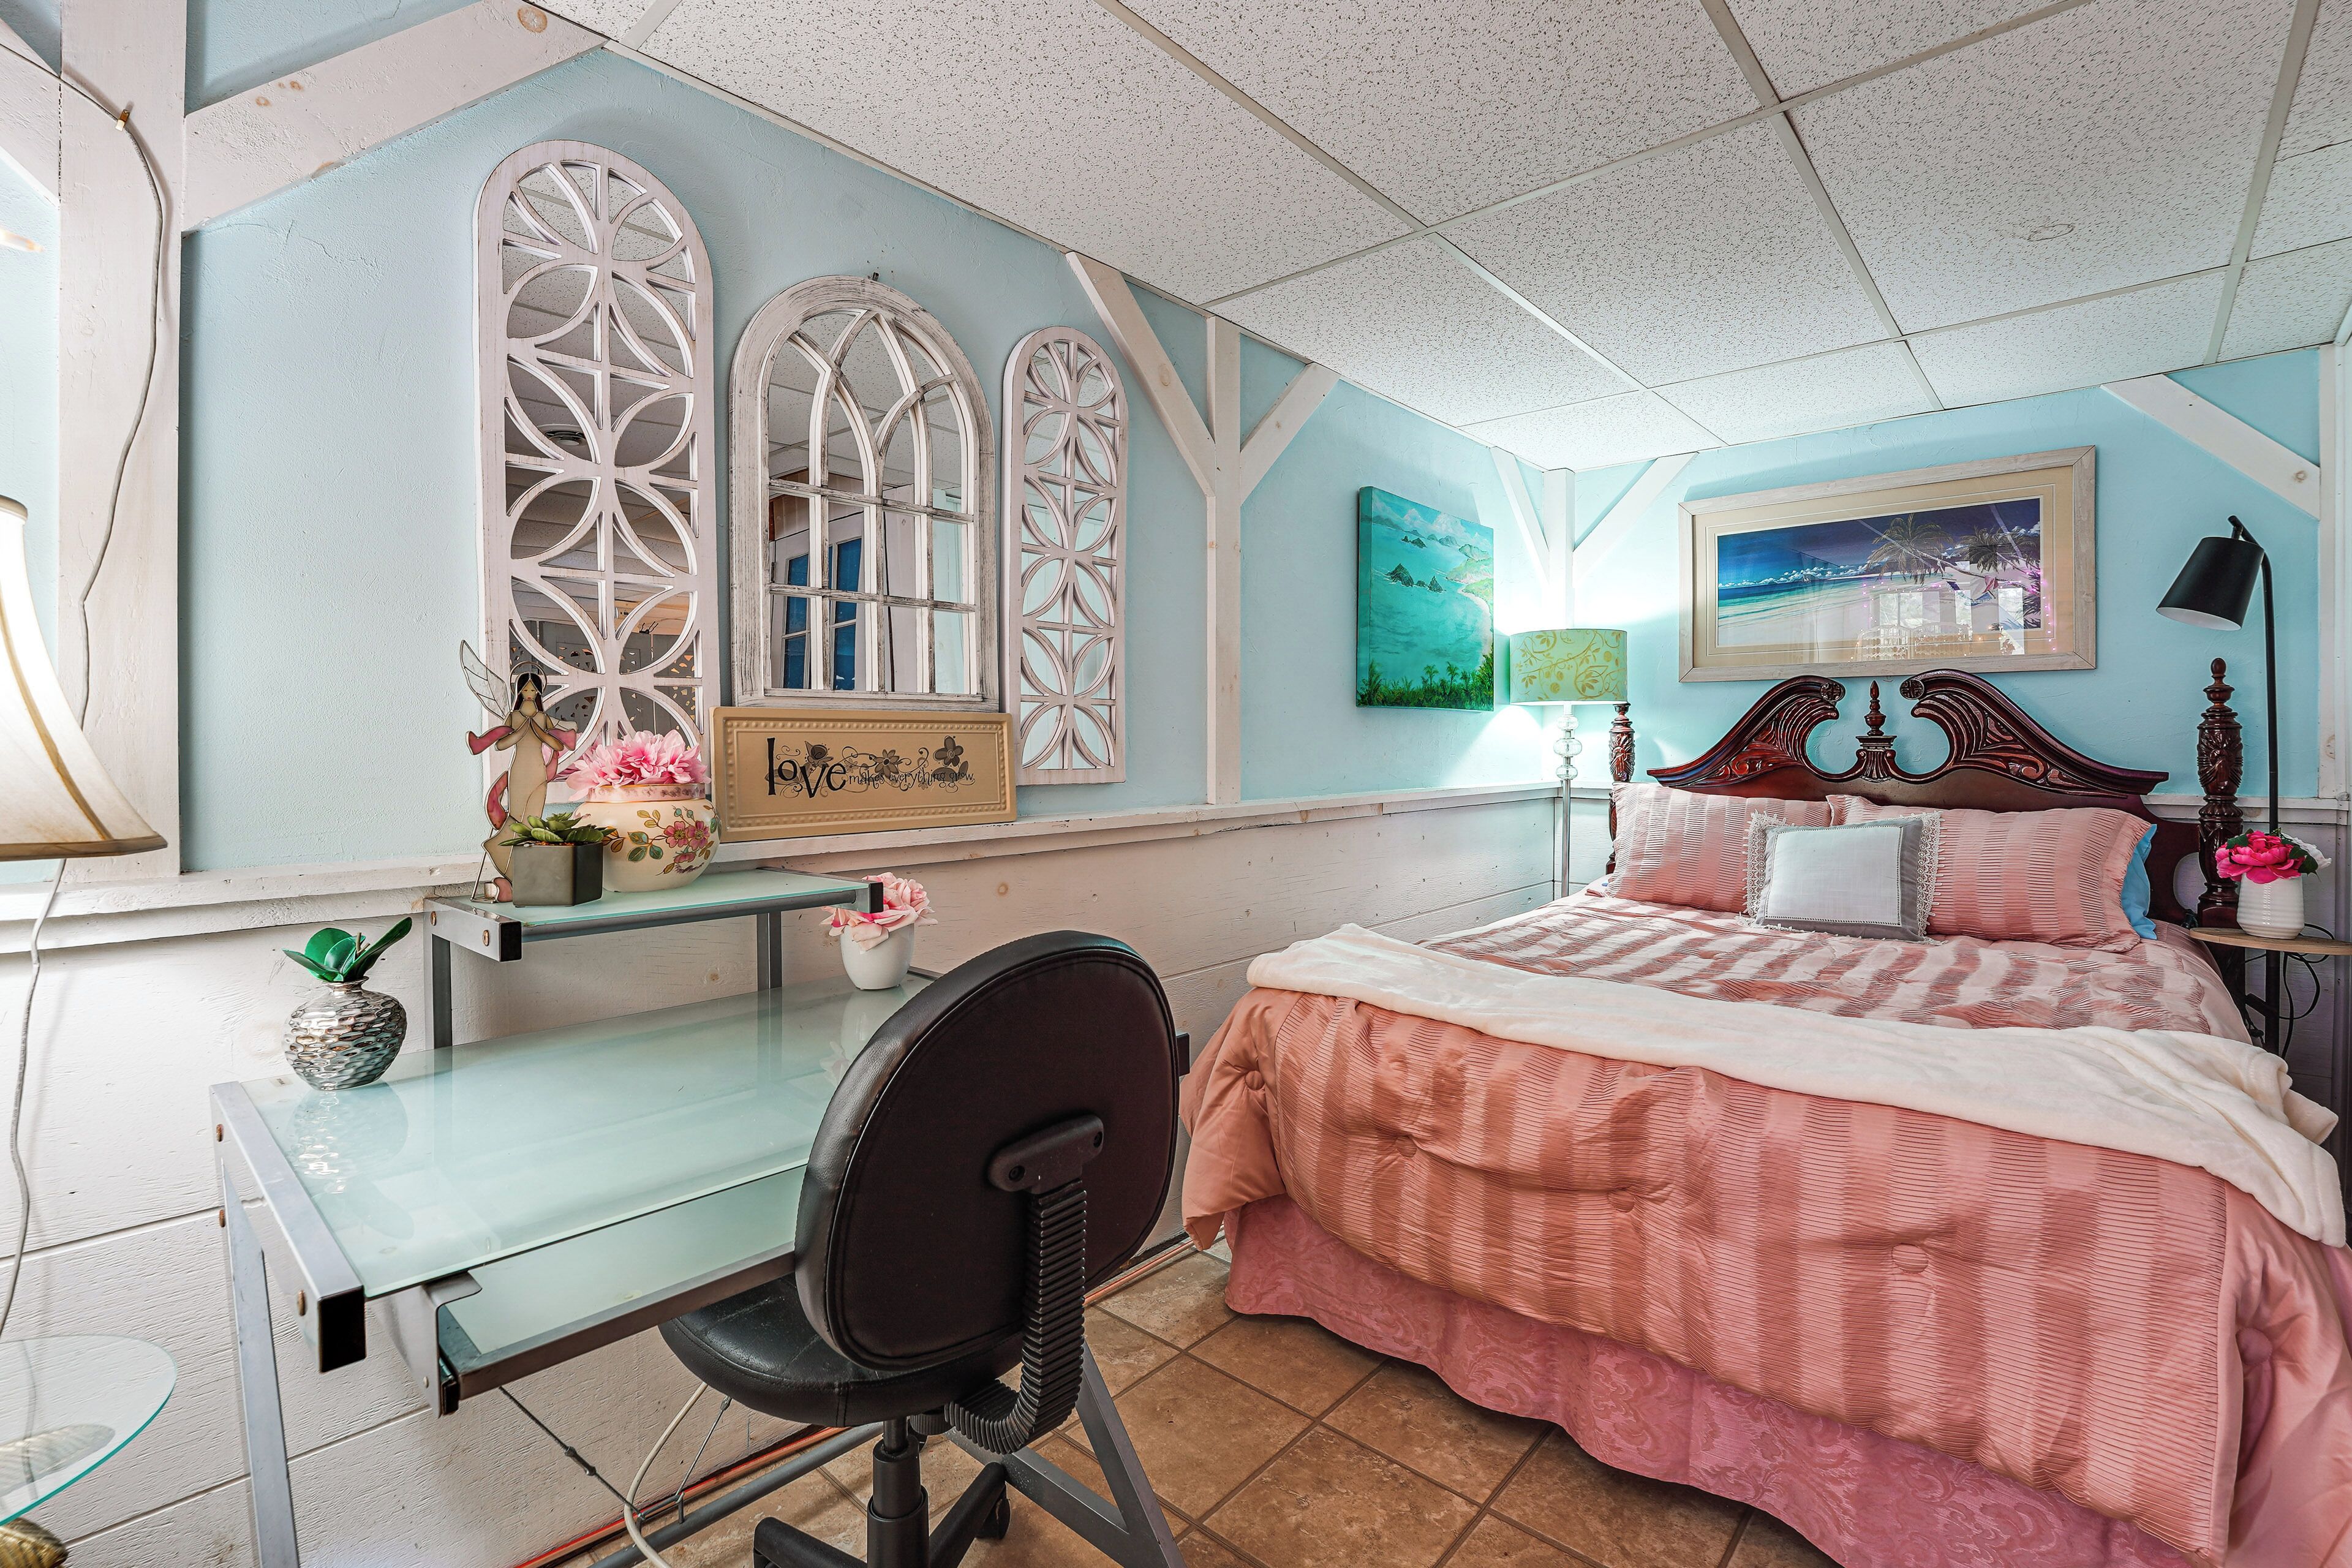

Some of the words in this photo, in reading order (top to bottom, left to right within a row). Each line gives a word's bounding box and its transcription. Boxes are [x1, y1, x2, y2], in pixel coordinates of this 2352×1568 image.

[767, 737, 846, 798] love
[850, 770, 884, 789] makes
[889, 767, 946, 791] everything
